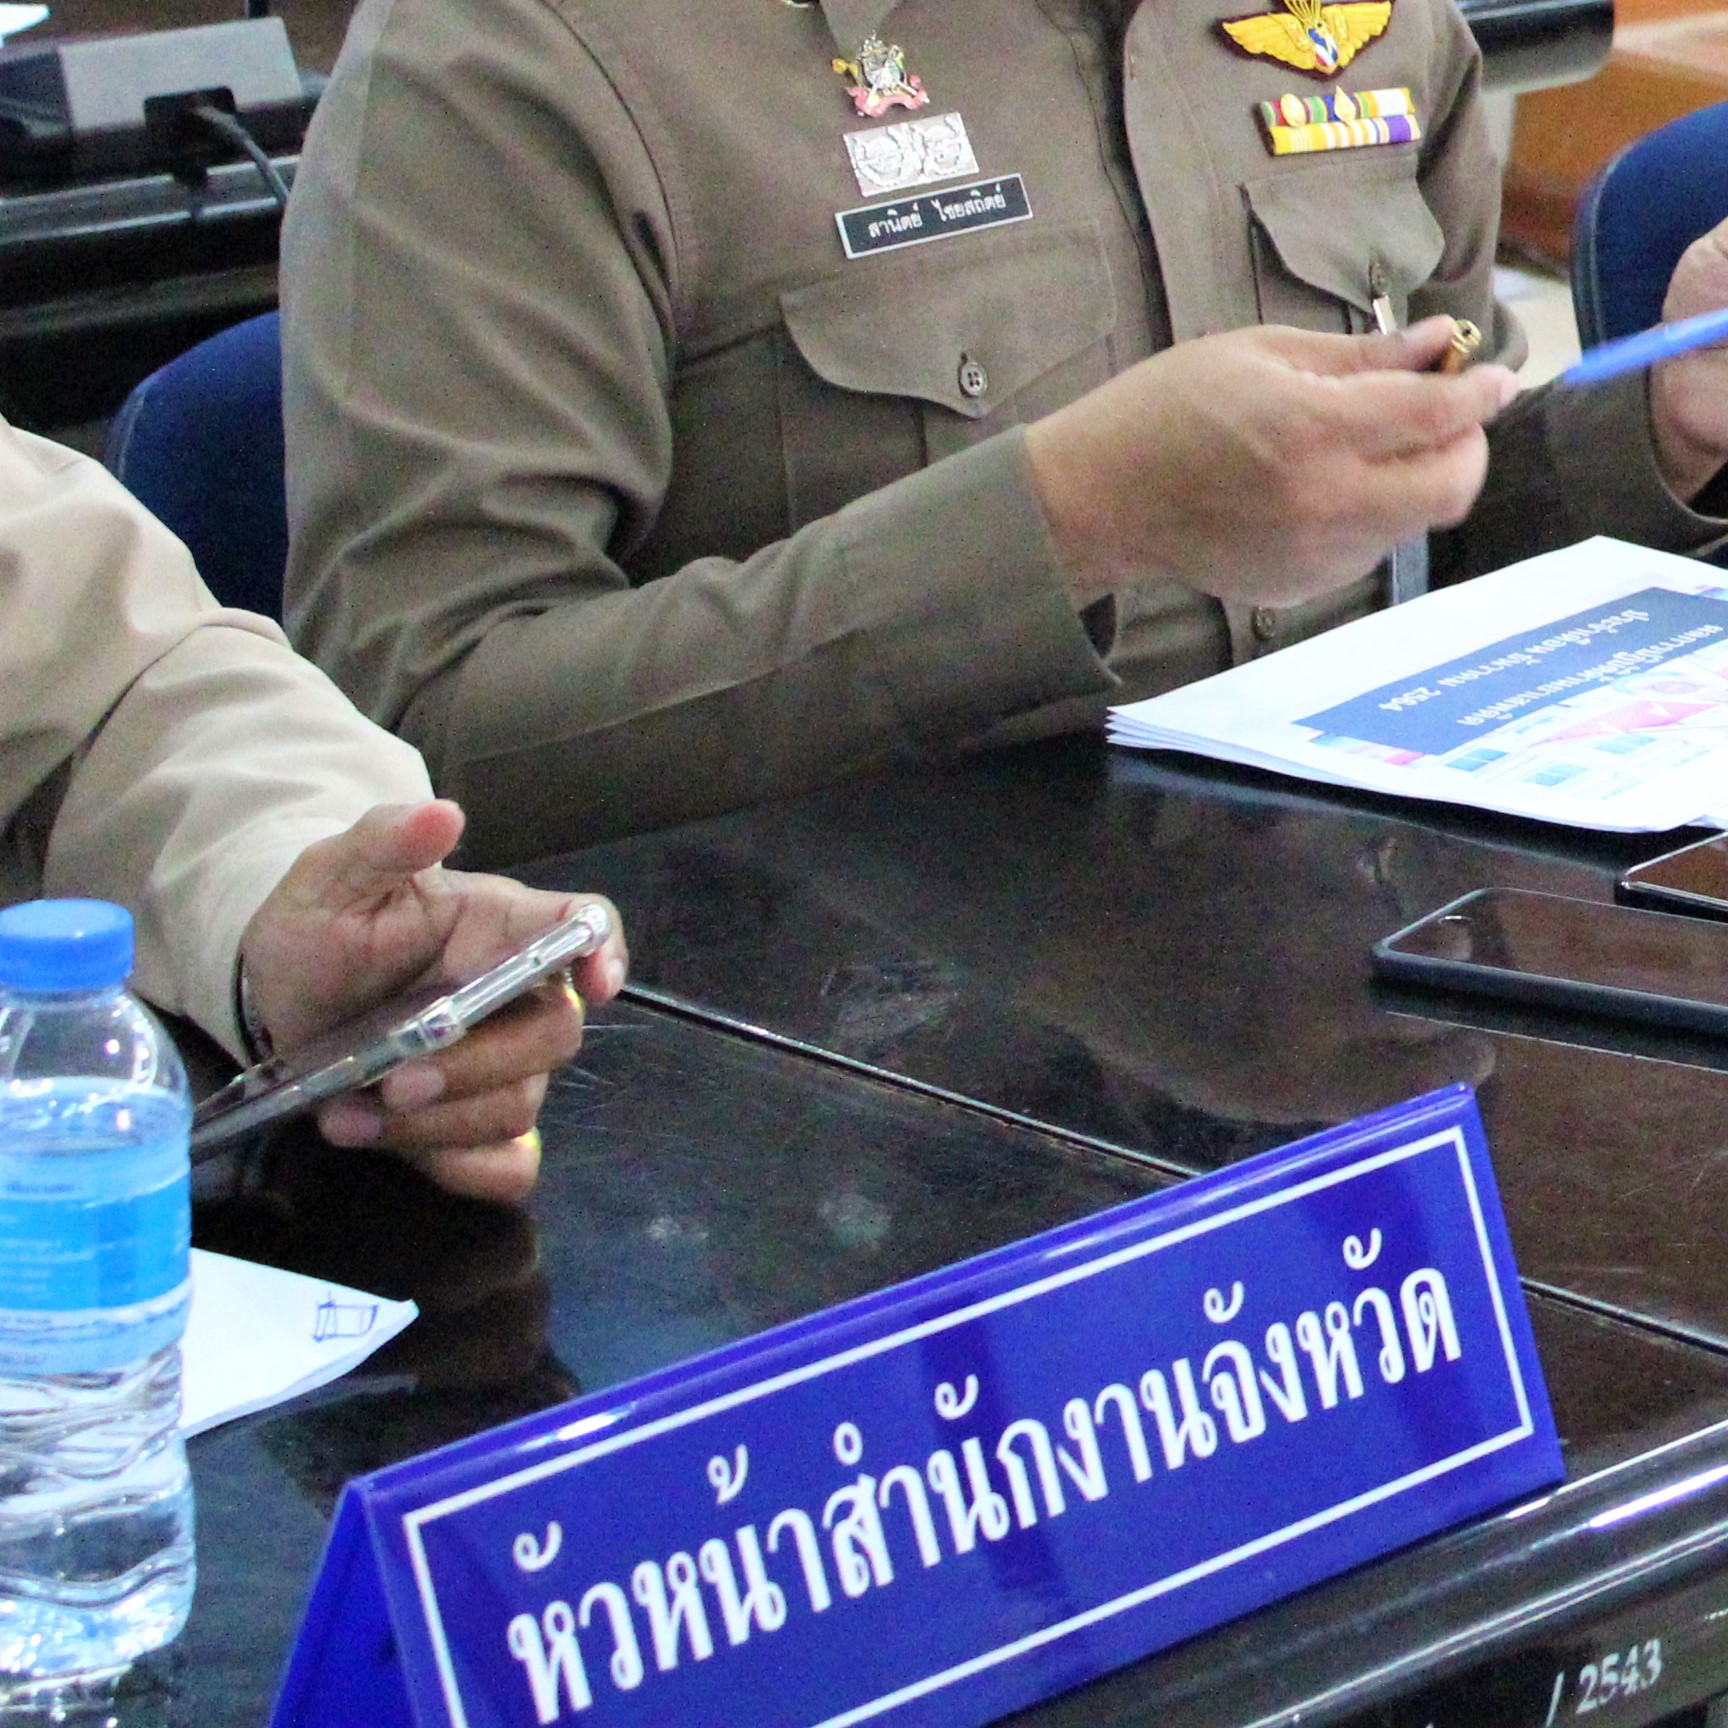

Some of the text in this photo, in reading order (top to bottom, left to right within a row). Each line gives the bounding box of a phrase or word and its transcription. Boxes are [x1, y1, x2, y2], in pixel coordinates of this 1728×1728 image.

[506, 1227, 1464, 1728] หัวหน้าสำนักงานจังหวัด
